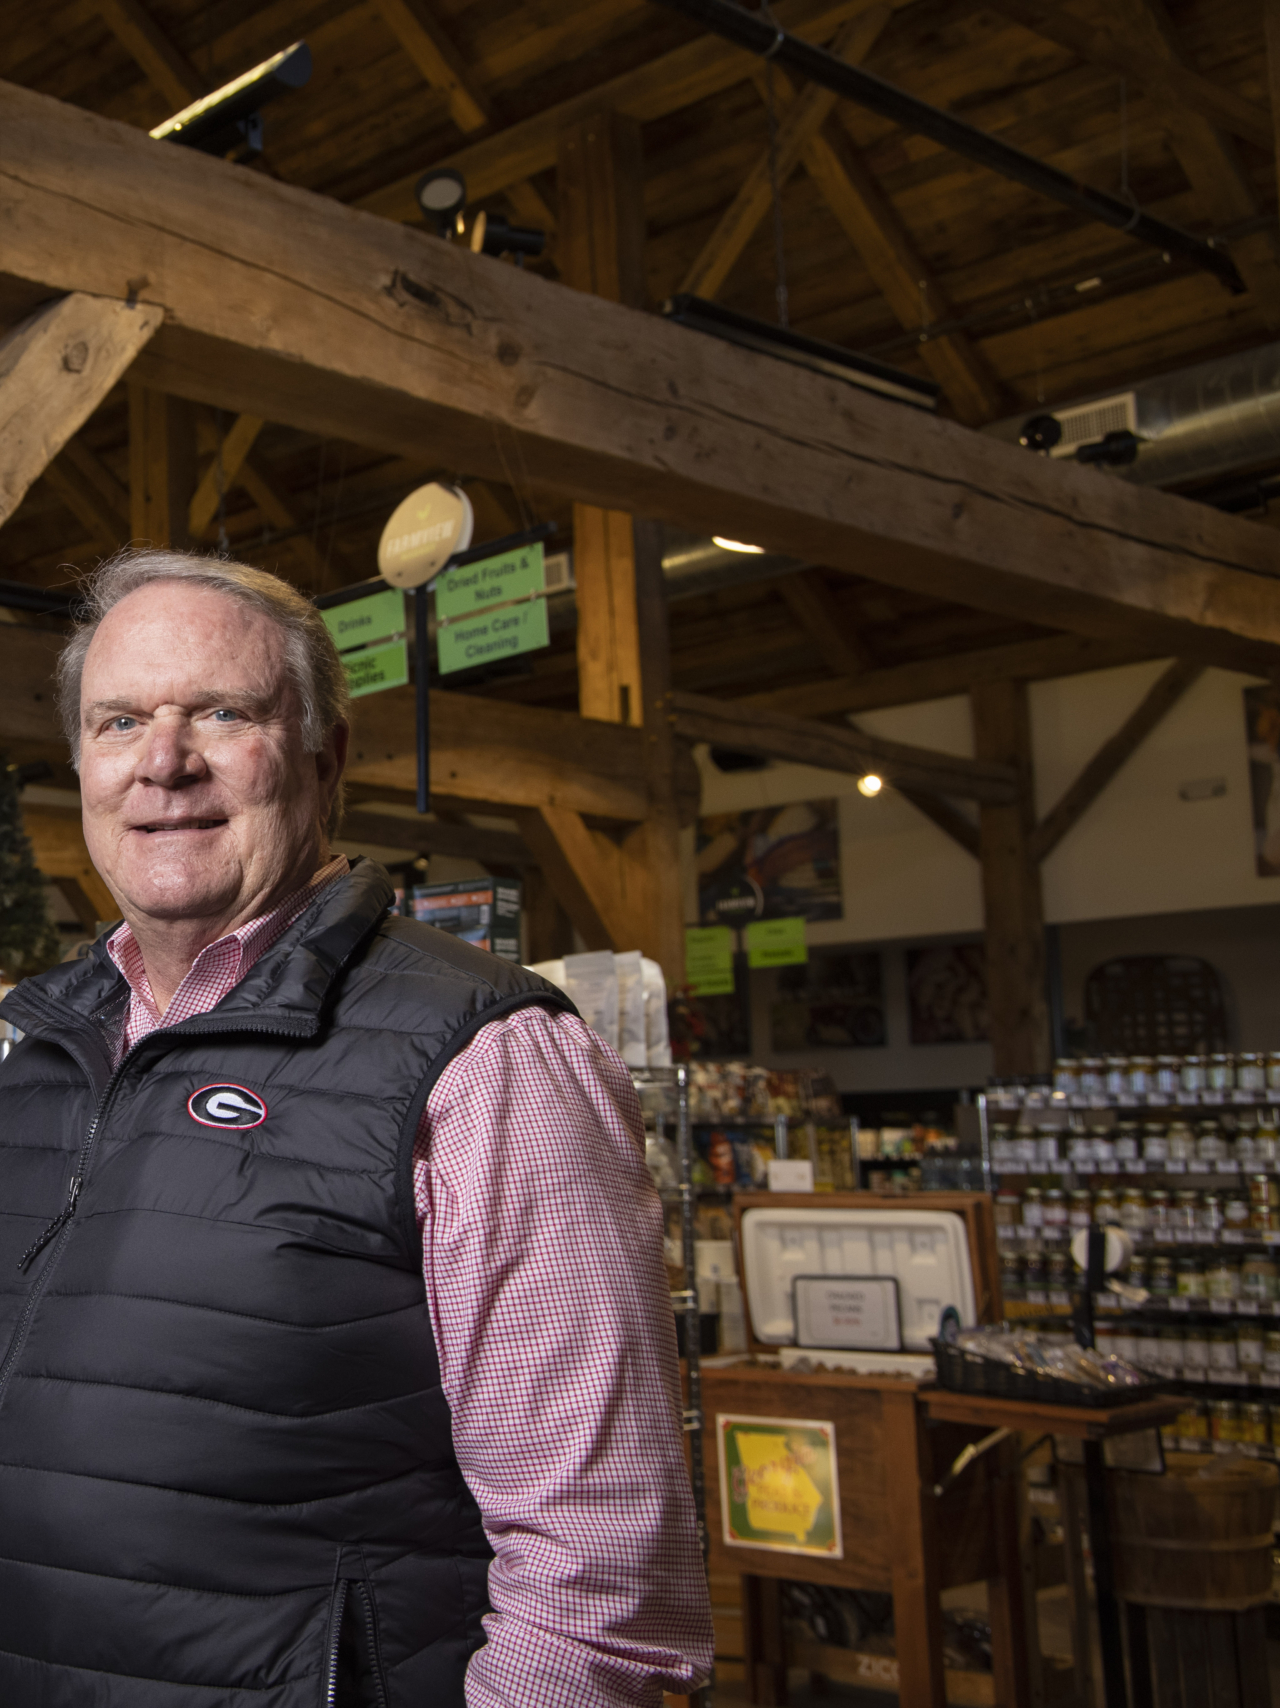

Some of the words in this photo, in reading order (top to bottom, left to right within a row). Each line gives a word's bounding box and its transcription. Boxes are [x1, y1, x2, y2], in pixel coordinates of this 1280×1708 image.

[446, 572, 480, 592] Dried
[482, 563, 517, 581] Fruits
[519, 556, 530, 570] &
[474, 586, 503, 600] Nuts
[338, 616, 372, 634] Drinks
[454, 625, 489, 643] Home
[491, 615, 520, 633] Care
[465, 635, 520, 659] Cleaning
